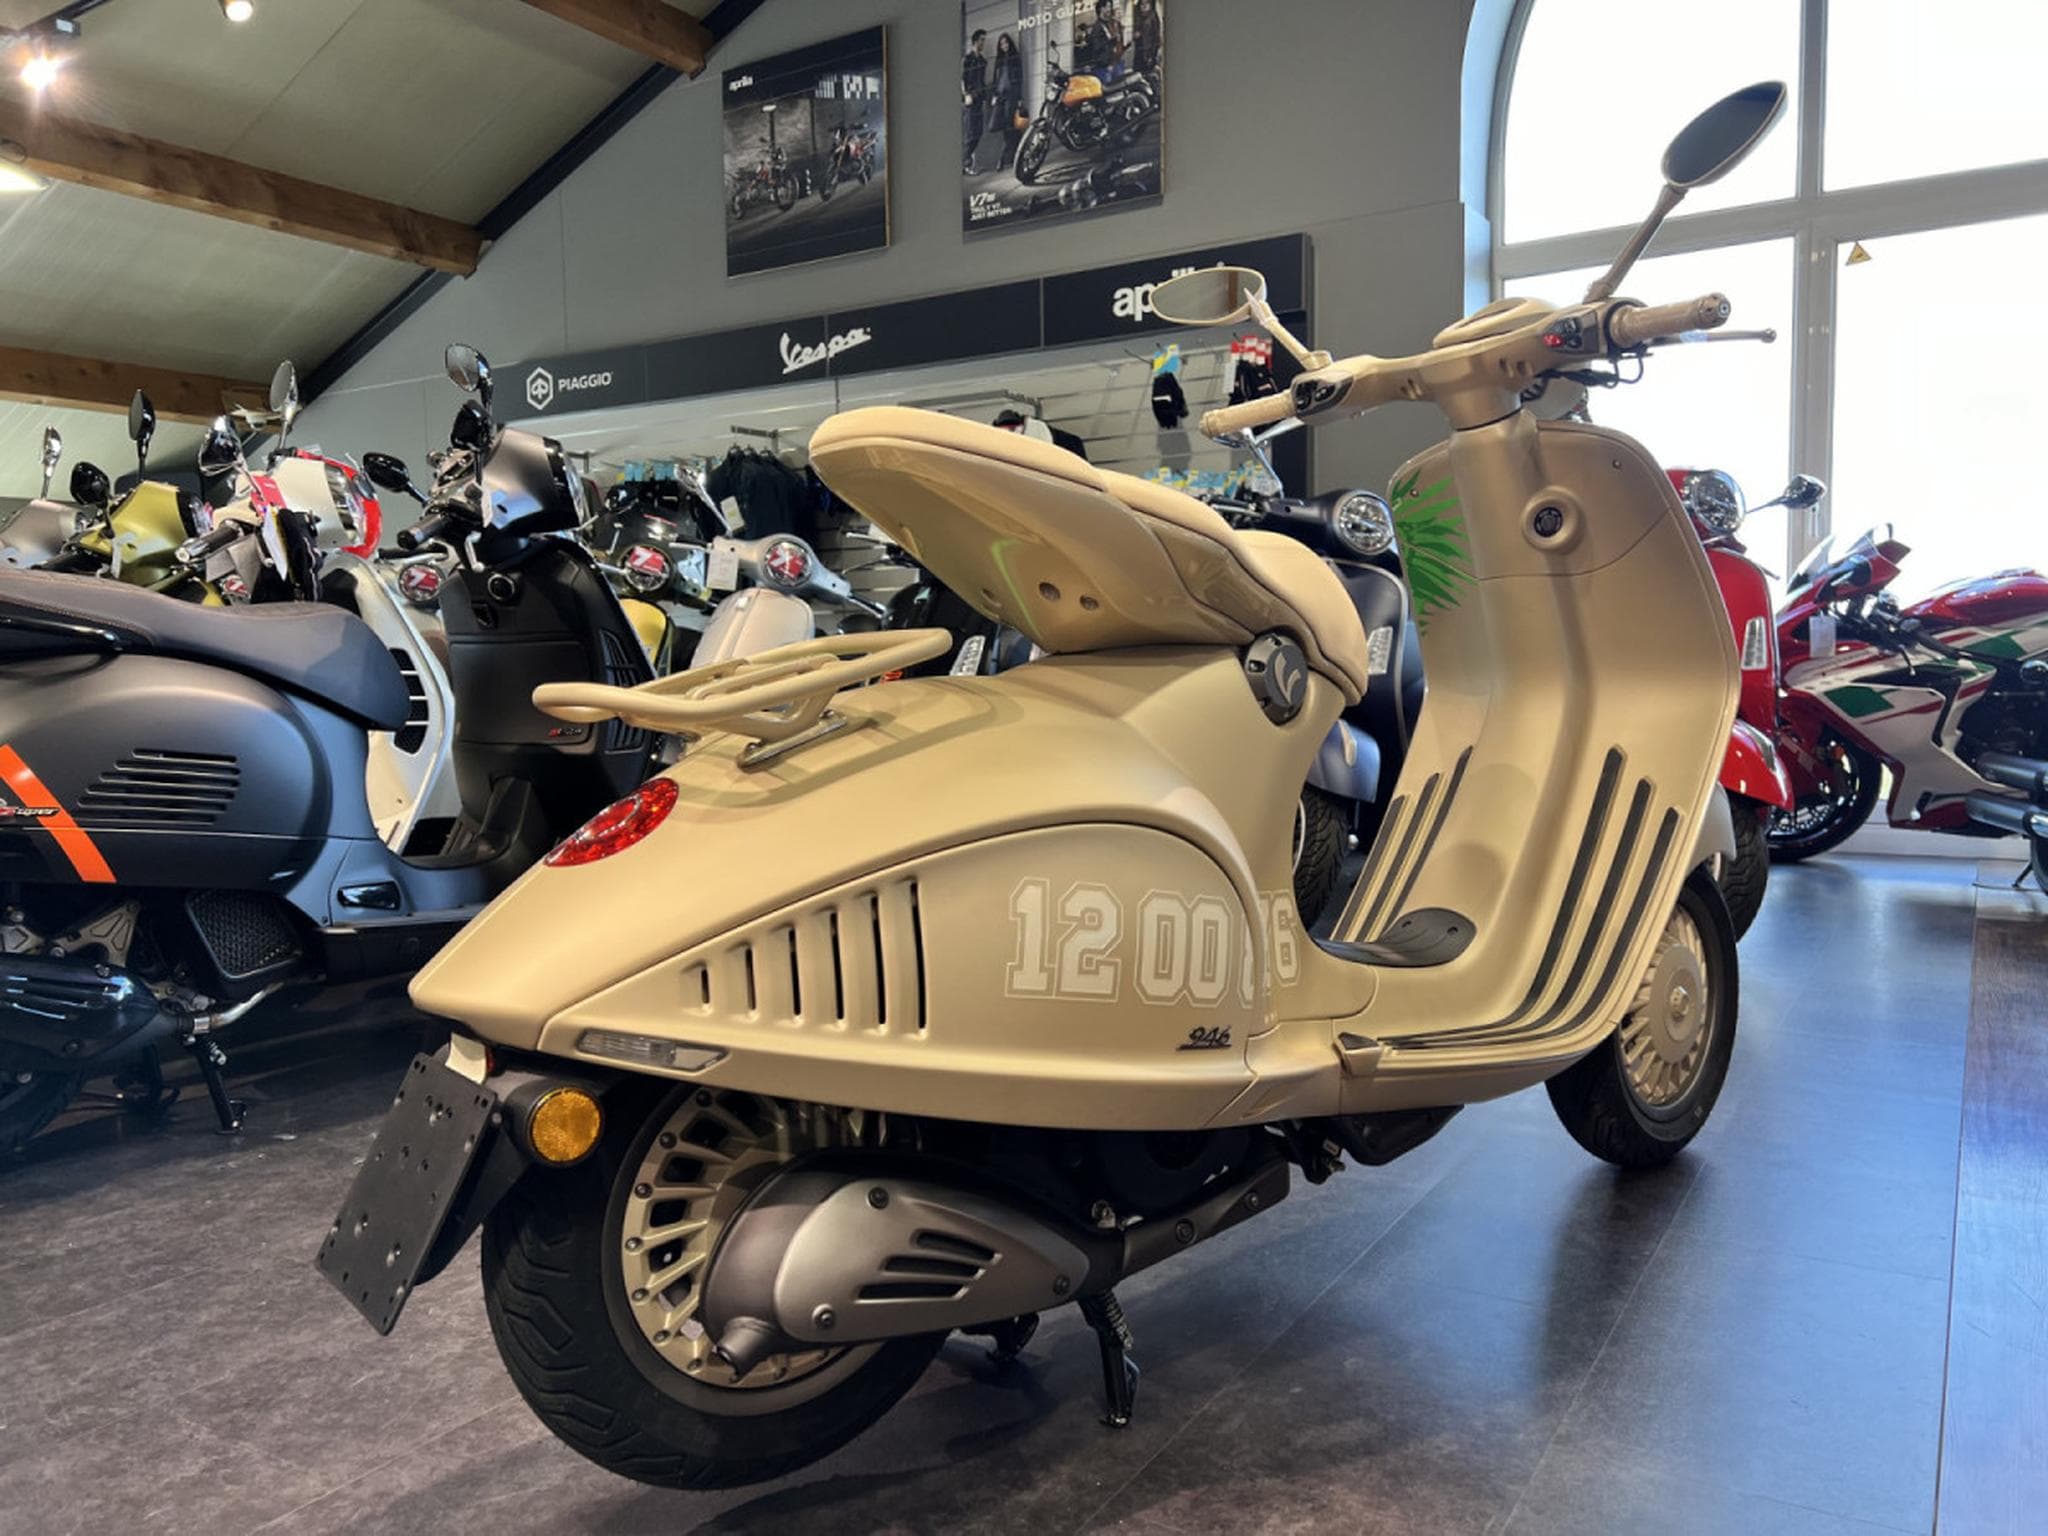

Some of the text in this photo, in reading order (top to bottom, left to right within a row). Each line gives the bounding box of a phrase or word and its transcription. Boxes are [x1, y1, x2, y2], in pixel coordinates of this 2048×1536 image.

[1017, 12, 1052, 30] MOTO
[780, 327, 871, 375] Vespa
[558, 371, 613, 392] PIAGGIO
